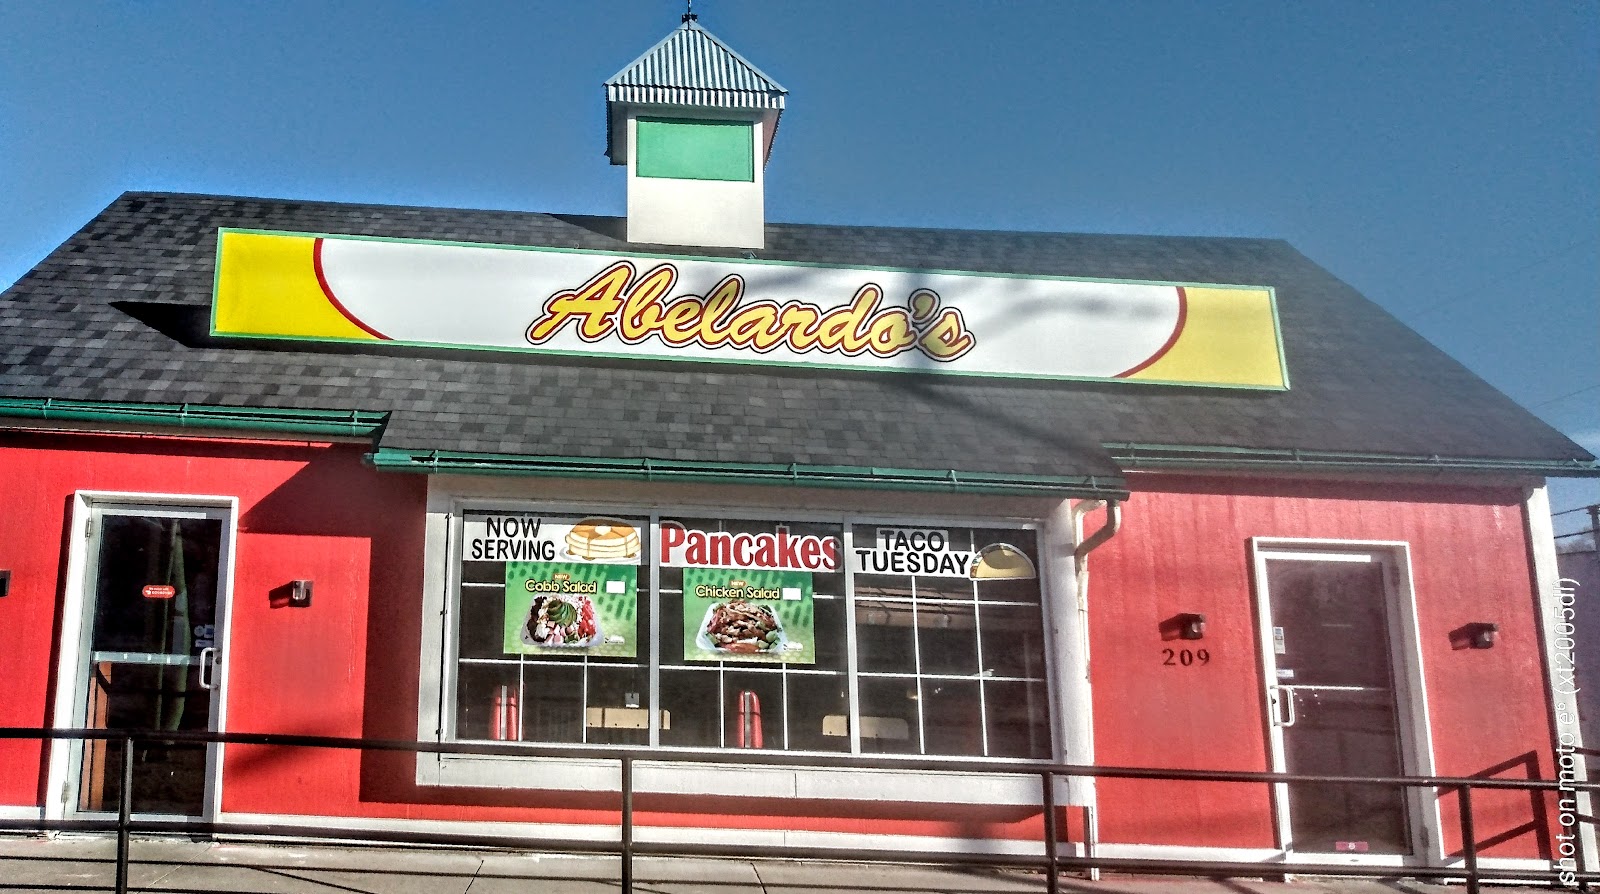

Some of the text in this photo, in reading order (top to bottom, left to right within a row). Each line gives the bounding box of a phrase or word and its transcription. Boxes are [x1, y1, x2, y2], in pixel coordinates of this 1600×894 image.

[527, 261, 975, 361] Abelardo's
[486, 517, 541, 538] NOW
[471, 539, 555, 561] SERVING
[660, 522, 842, 570] Pancakes
[879, 530, 945, 552] TACO
[855, 550, 969, 575] TUESDAY
[525, 579, 598, 594] Cobb Salad
[695, 585, 780, 600] Chicken Salad
[1162, 648, 1210, 666] 209
